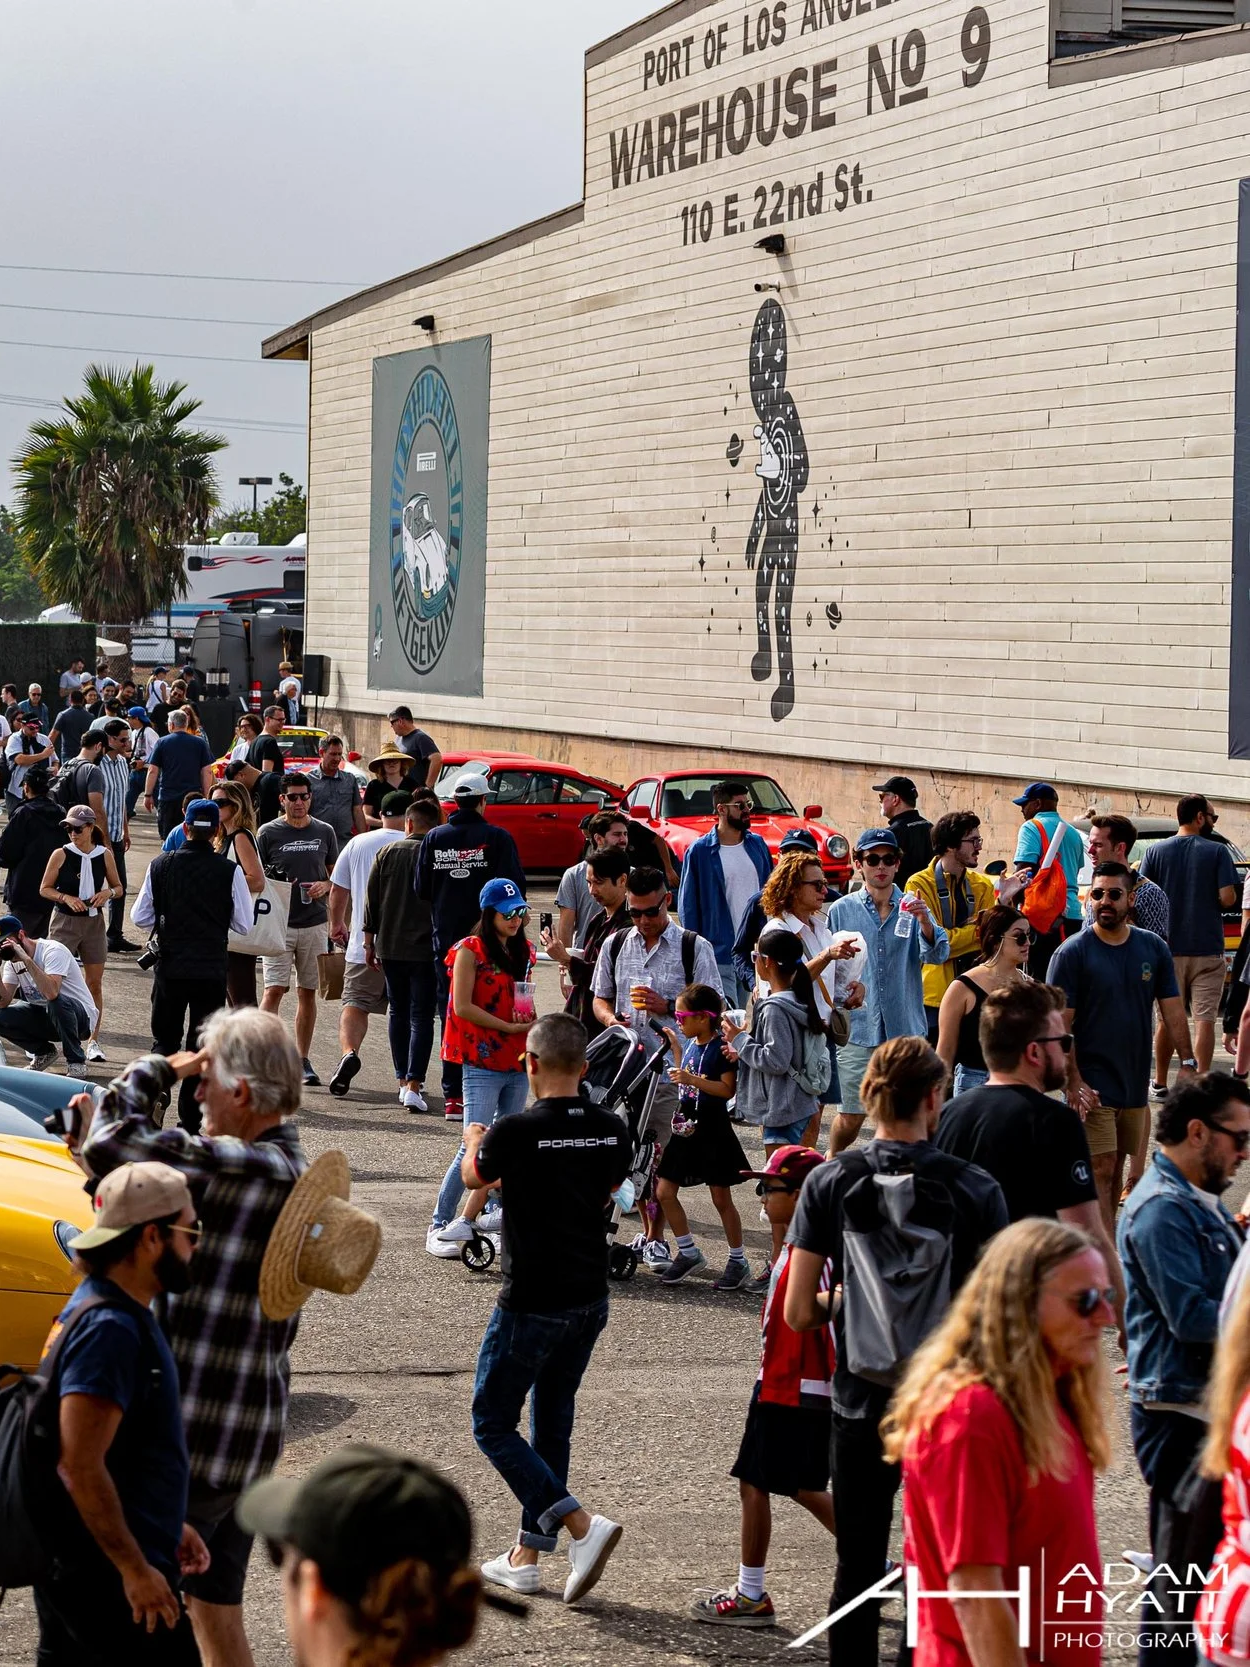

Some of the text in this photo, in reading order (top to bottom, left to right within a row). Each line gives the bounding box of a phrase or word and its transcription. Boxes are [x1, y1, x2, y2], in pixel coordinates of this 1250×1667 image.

[644, 36, 694, 91] PORT
[703, 22, 728, 70] OF
[743, 1, 787, 56] LOS
[609, 58, 837, 190] WAREHOUSE
[960, 6, 991, 89] 9
[681, 161, 873, 246] 110 E. 22nd St.
[433, 860, 489, 870] Manual Service
[538, 1136, 618, 1149] PORSCHE
